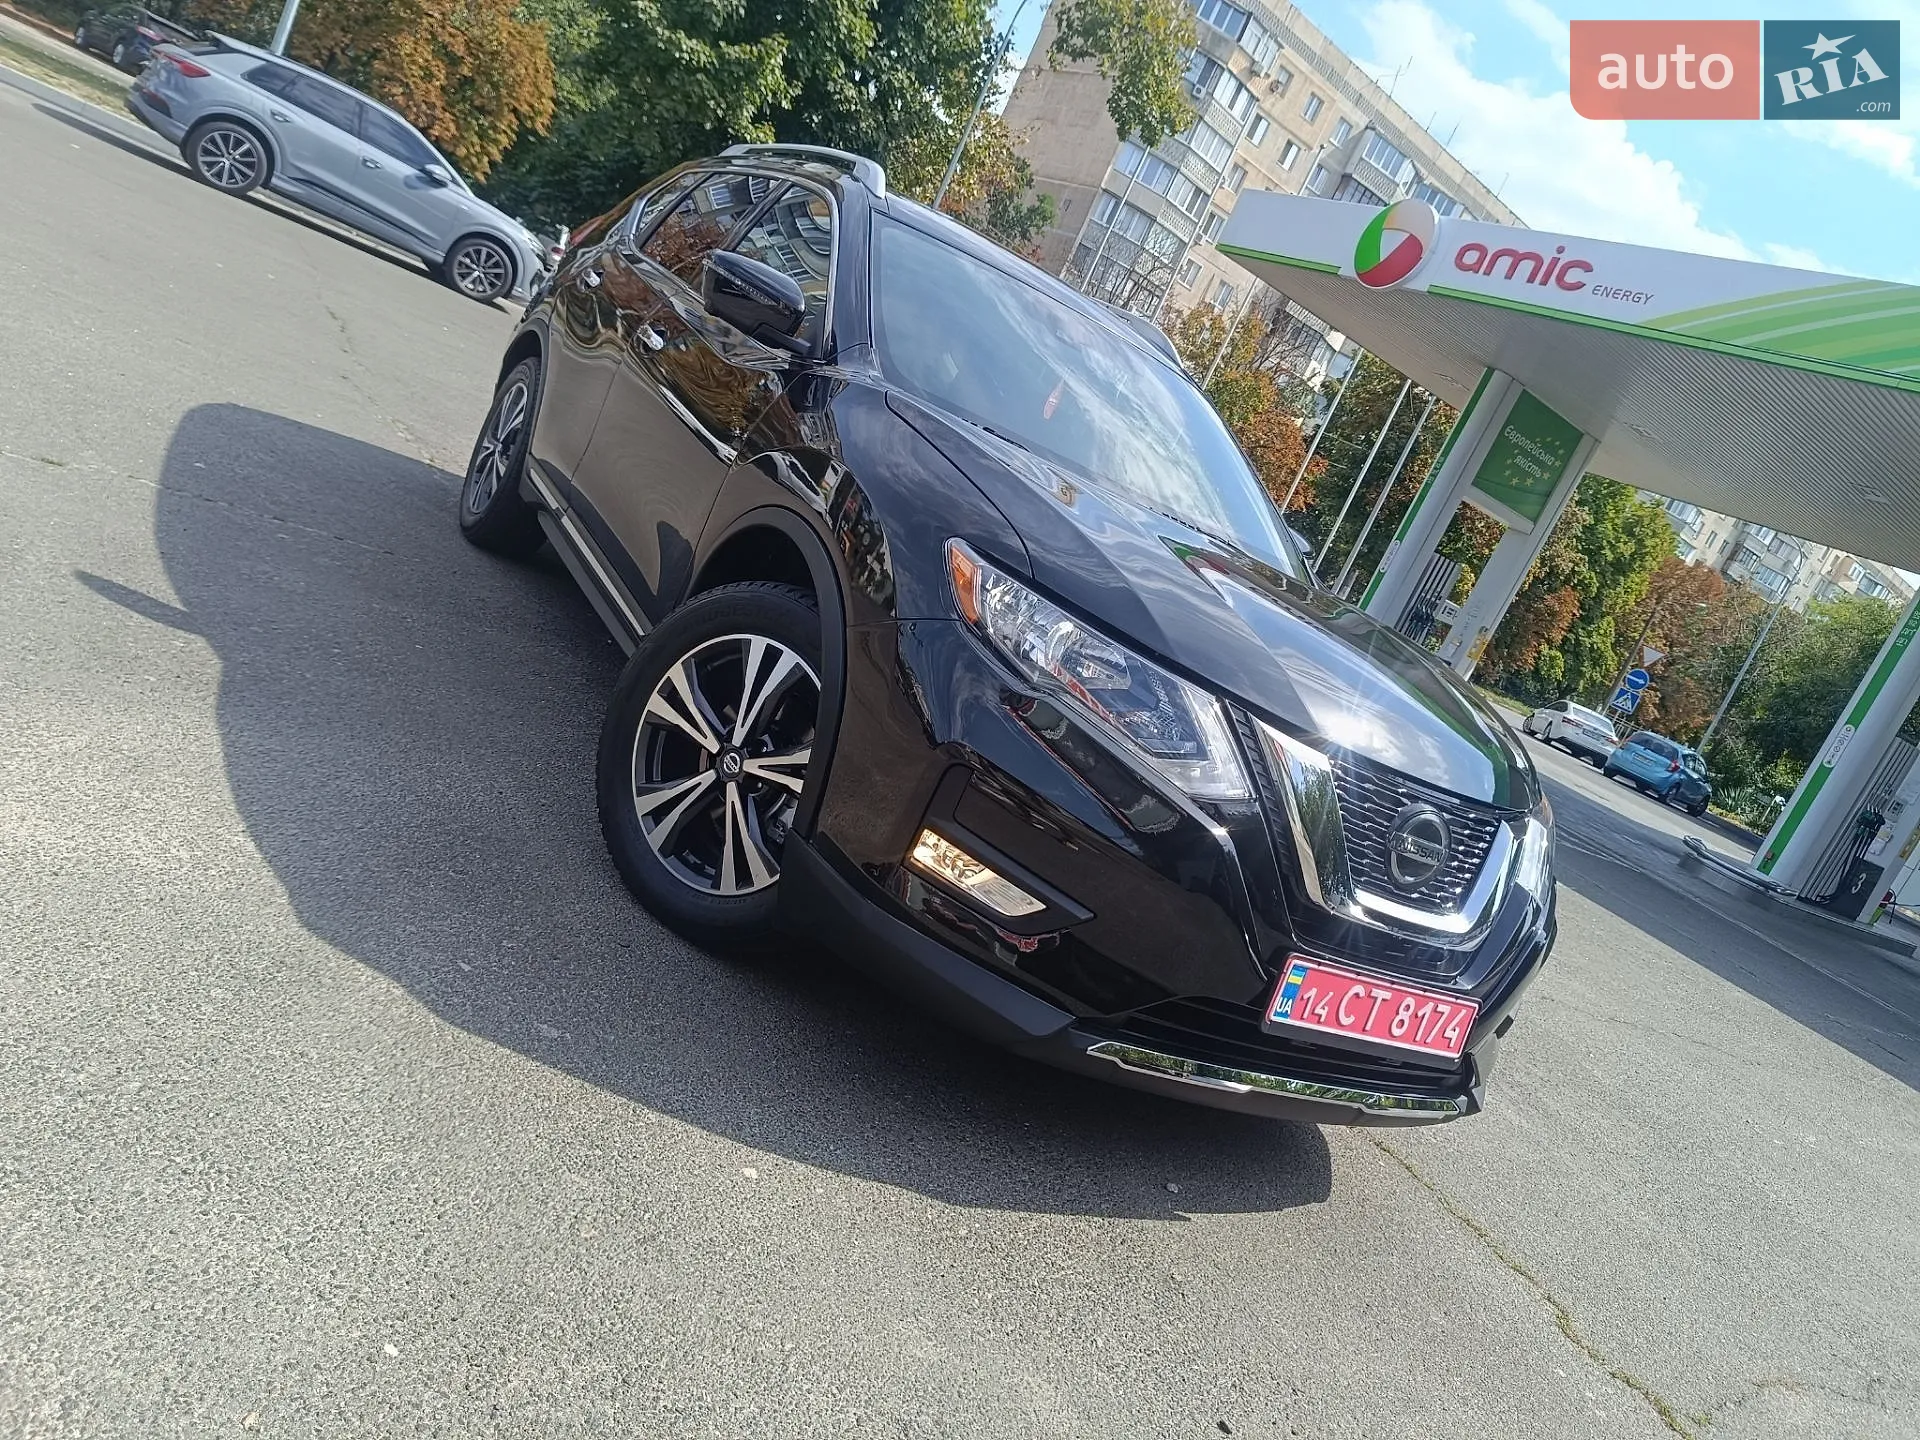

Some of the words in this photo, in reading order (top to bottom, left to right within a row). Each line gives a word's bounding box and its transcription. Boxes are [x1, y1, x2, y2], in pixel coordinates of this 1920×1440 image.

[1454, 242, 1594, 292] amic
[1591, 284, 1655, 306] ENERGY
[1504, 425, 1555, 466] Європейська
[1513, 455, 1542, 478] якість
[1399, 837, 1441, 863] NISSAN
[1851, 872, 1867, 895] 3
[1277, 996, 1293, 1015] UA
[1390, 996, 1467, 1048] 8174
